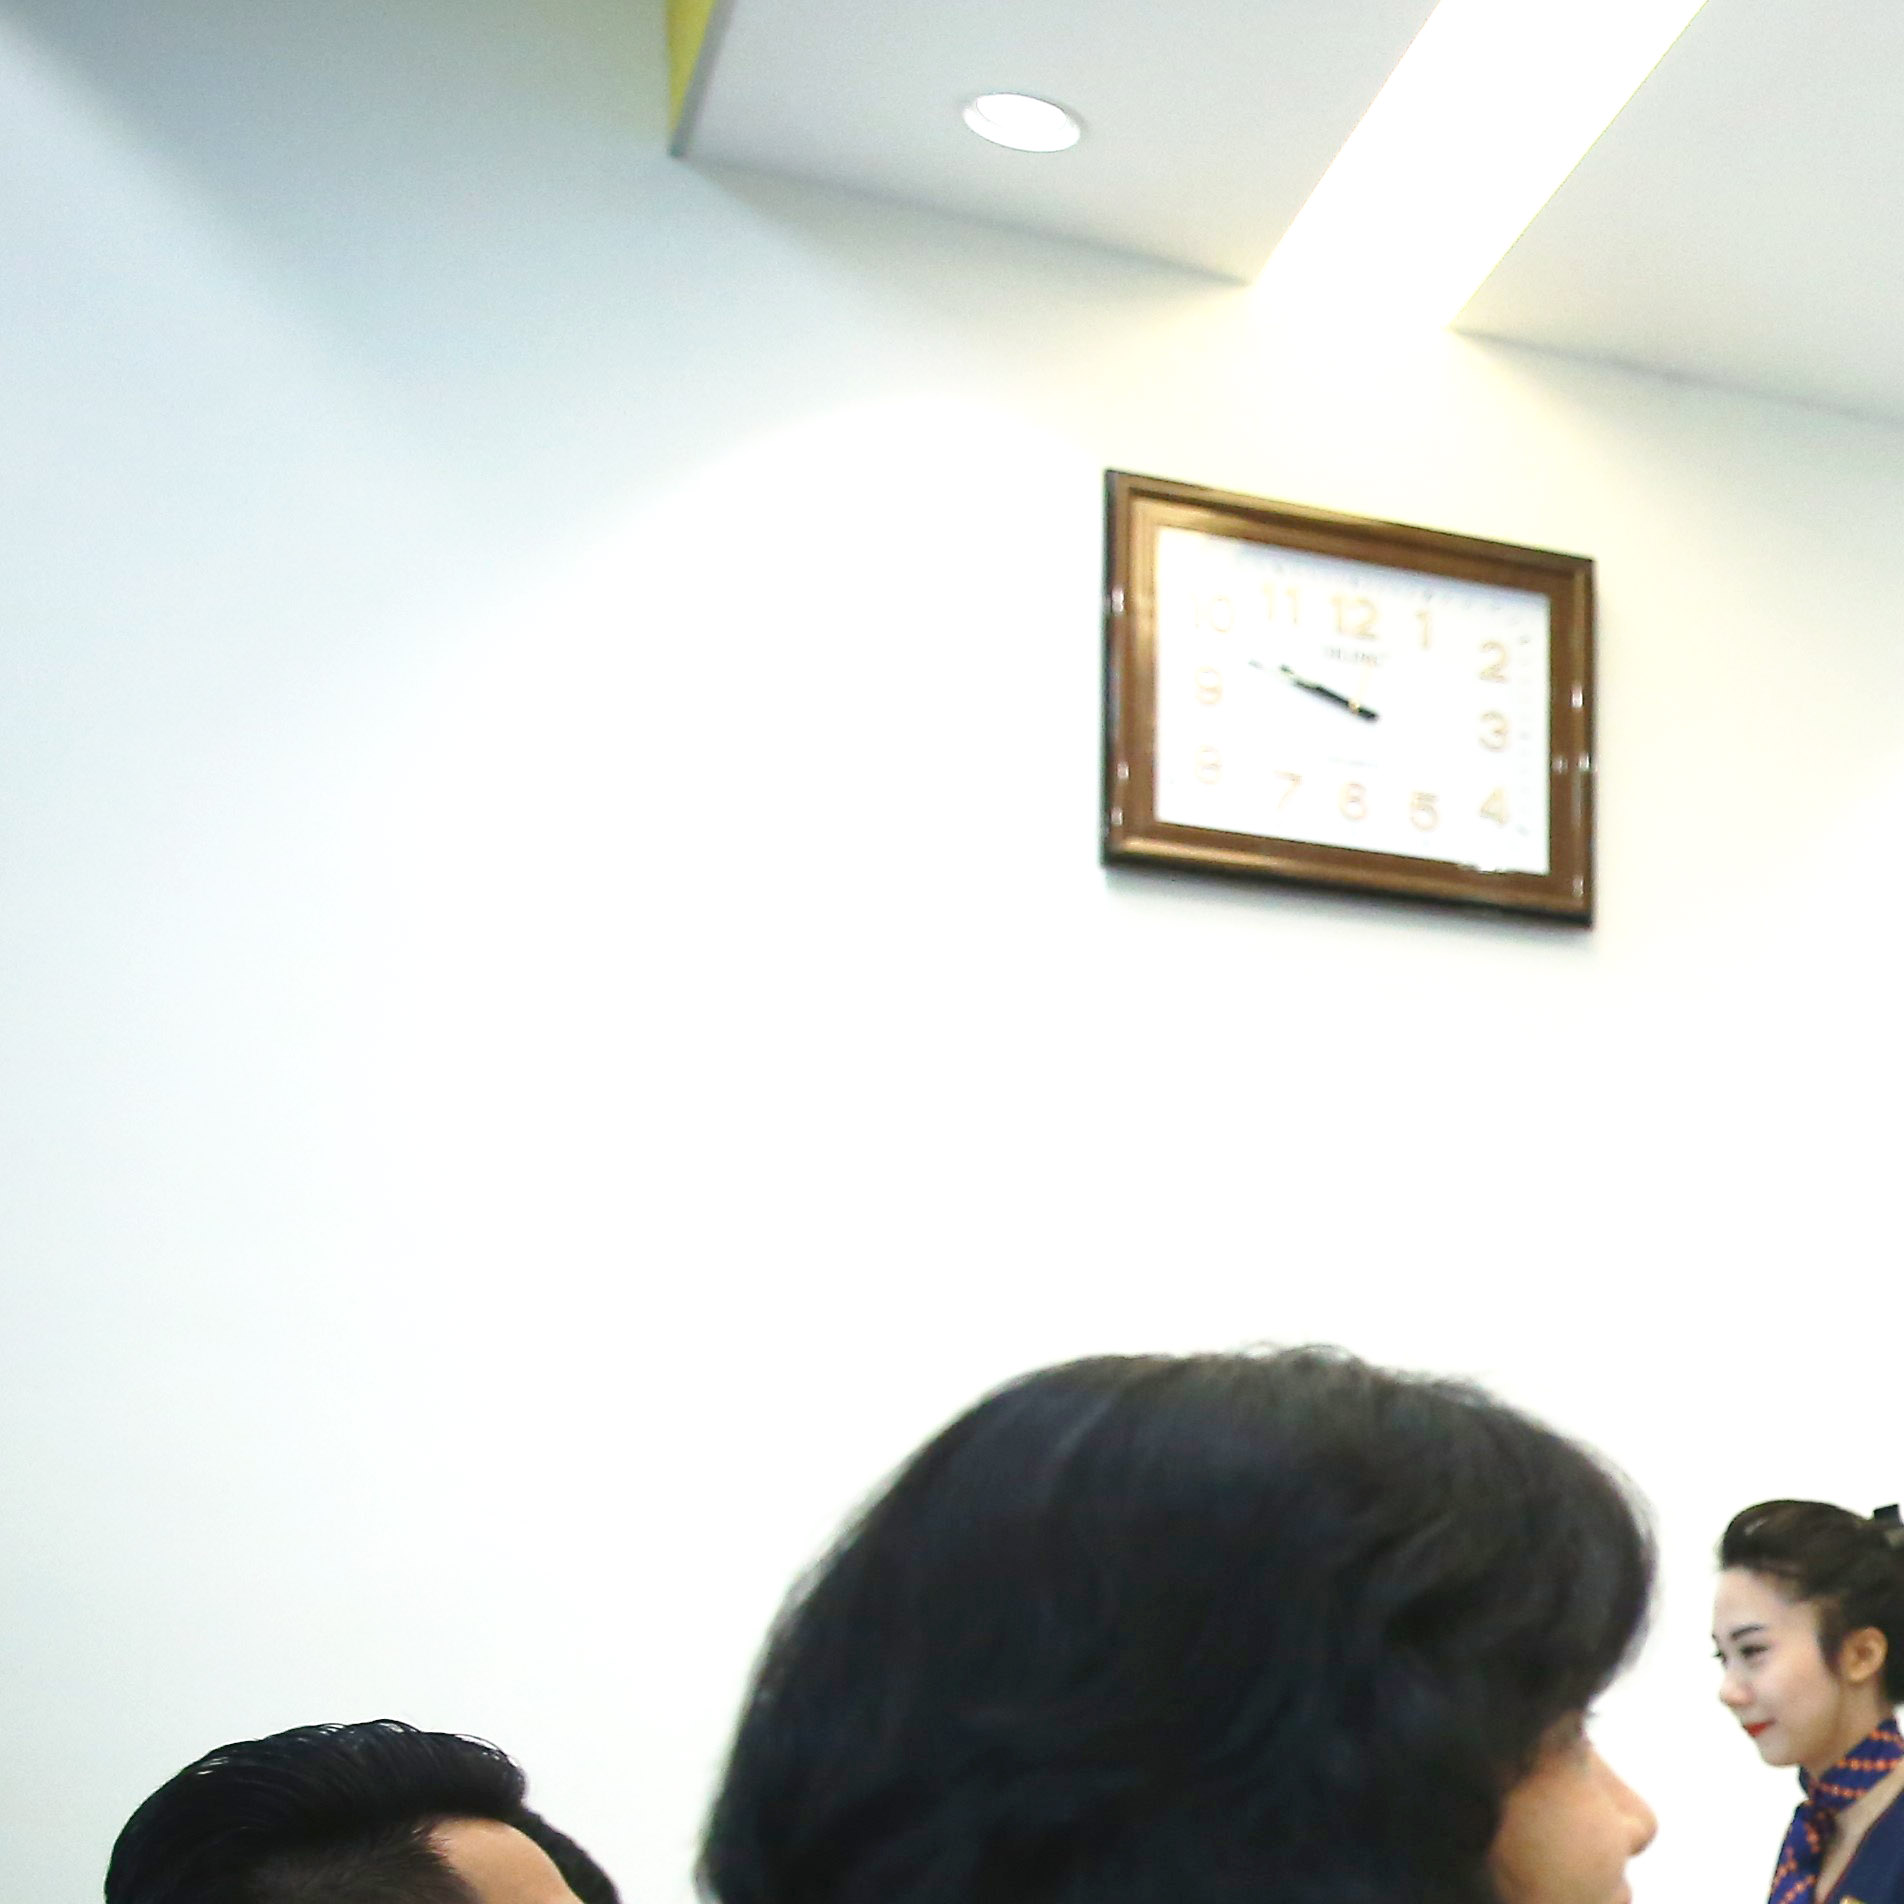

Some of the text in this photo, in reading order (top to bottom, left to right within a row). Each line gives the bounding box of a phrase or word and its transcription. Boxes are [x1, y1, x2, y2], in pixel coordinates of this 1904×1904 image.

[1330, 590, 1382, 641] 12
[1415, 608, 1434, 651] 1
[1478, 639, 1510, 684] 2
[1194, 665, 1223, 706] 9
[1479, 708, 1511, 753] 3
[1275, 769, 1303, 811] 7
[1409, 790, 1440, 833] 5
[1479, 786, 1511, 829] 4
